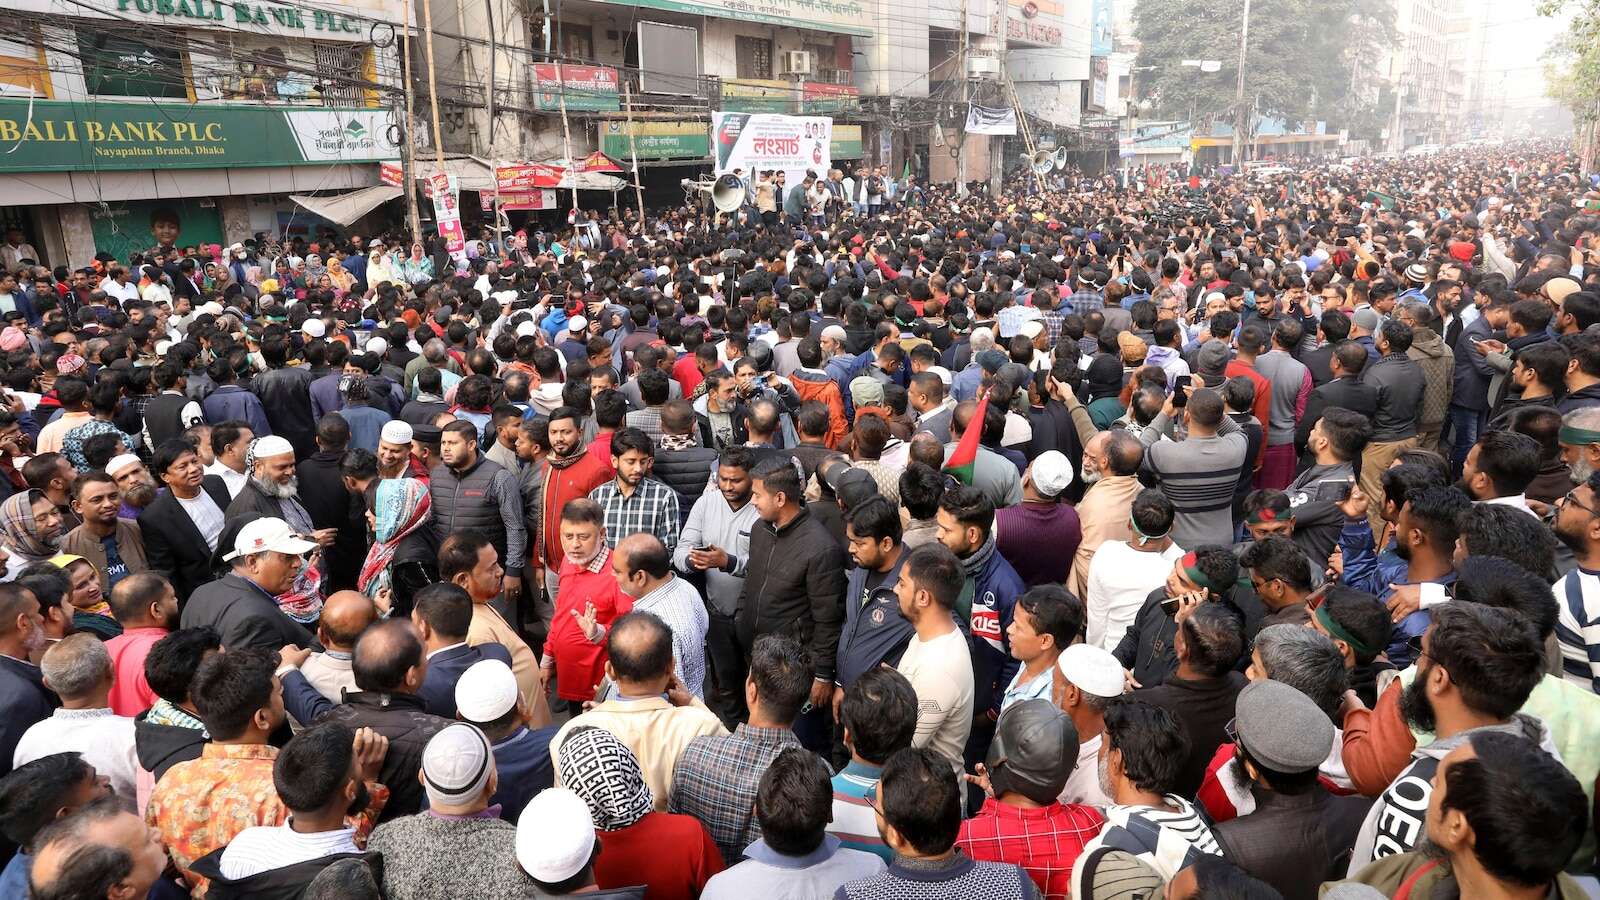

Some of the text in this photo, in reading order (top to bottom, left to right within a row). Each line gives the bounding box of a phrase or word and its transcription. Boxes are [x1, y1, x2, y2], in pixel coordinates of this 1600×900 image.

[233, 2, 306, 28] BANK
[313, 8, 361, 33] PLC.
[0, 119, 228, 142] BALI BANK PLC.
[95, 146, 225, 158] Nayapaltan Branch, Dhaka
[753, 135, 800, 155] লংমার্চ
